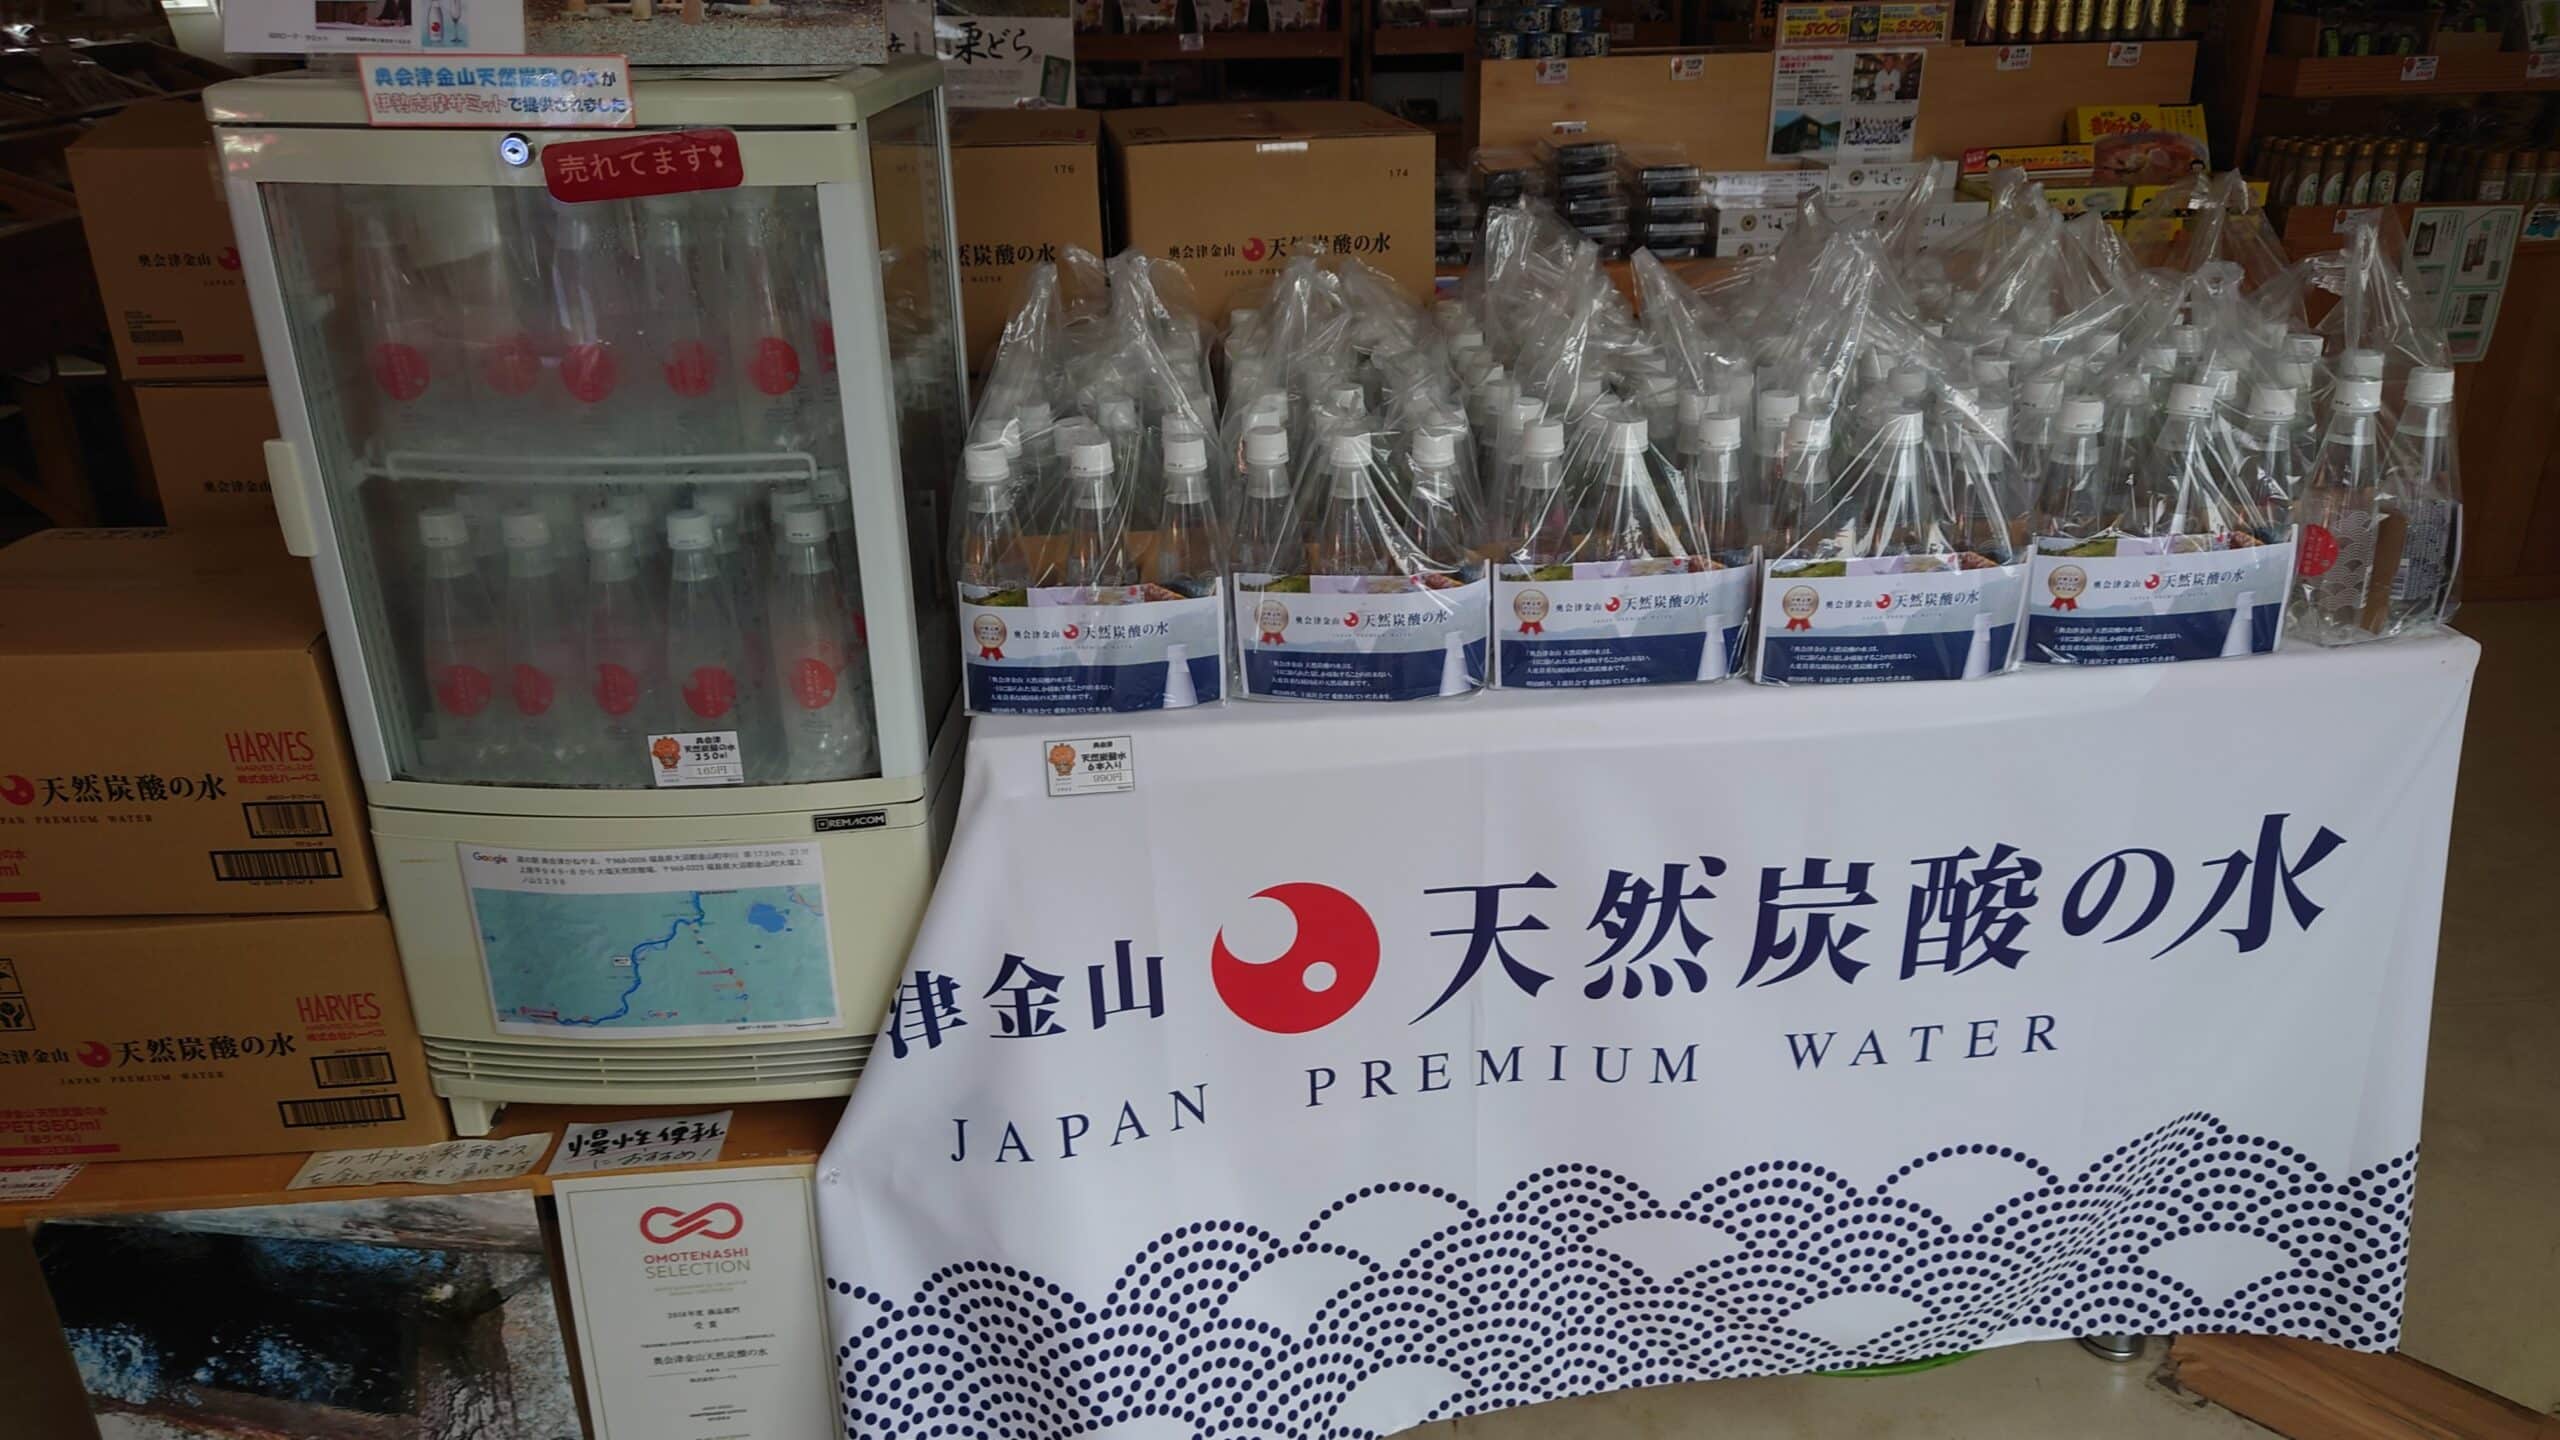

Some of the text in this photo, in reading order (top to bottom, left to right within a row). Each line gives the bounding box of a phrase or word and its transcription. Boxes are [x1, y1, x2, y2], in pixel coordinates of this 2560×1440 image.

[954, 21, 1032, 64] 栗どら
[2164, 568, 2245, 588] 天然炭酸の水
[1624, 592, 1709, 611] 天然炭酸の水
[1895, 589, 1980, 609] 天然炭酸の水
[1364, 609, 1448, 627] 天然炭酸の水
[1085, 621, 1169, 640] 天然炭酸の水
[225, 730, 314, 762] HARVES
[37, 773, 227, 807] 天然炭酸の水
[473, 851, 508, 864] Google
[885, 812, 2347, 1059] 津金山 天然炭酸の水
[296, 992, 381, 1022] HARVES
[114, 1032, 297, 1068] 天然炭酸の水
[951, 1014, 2059, 1163] JAPAN PREMIUM WATER
[643, 1247, 748, 1265] OMOTENASHI
[645, 1258, 750, 1280] SELECTION
